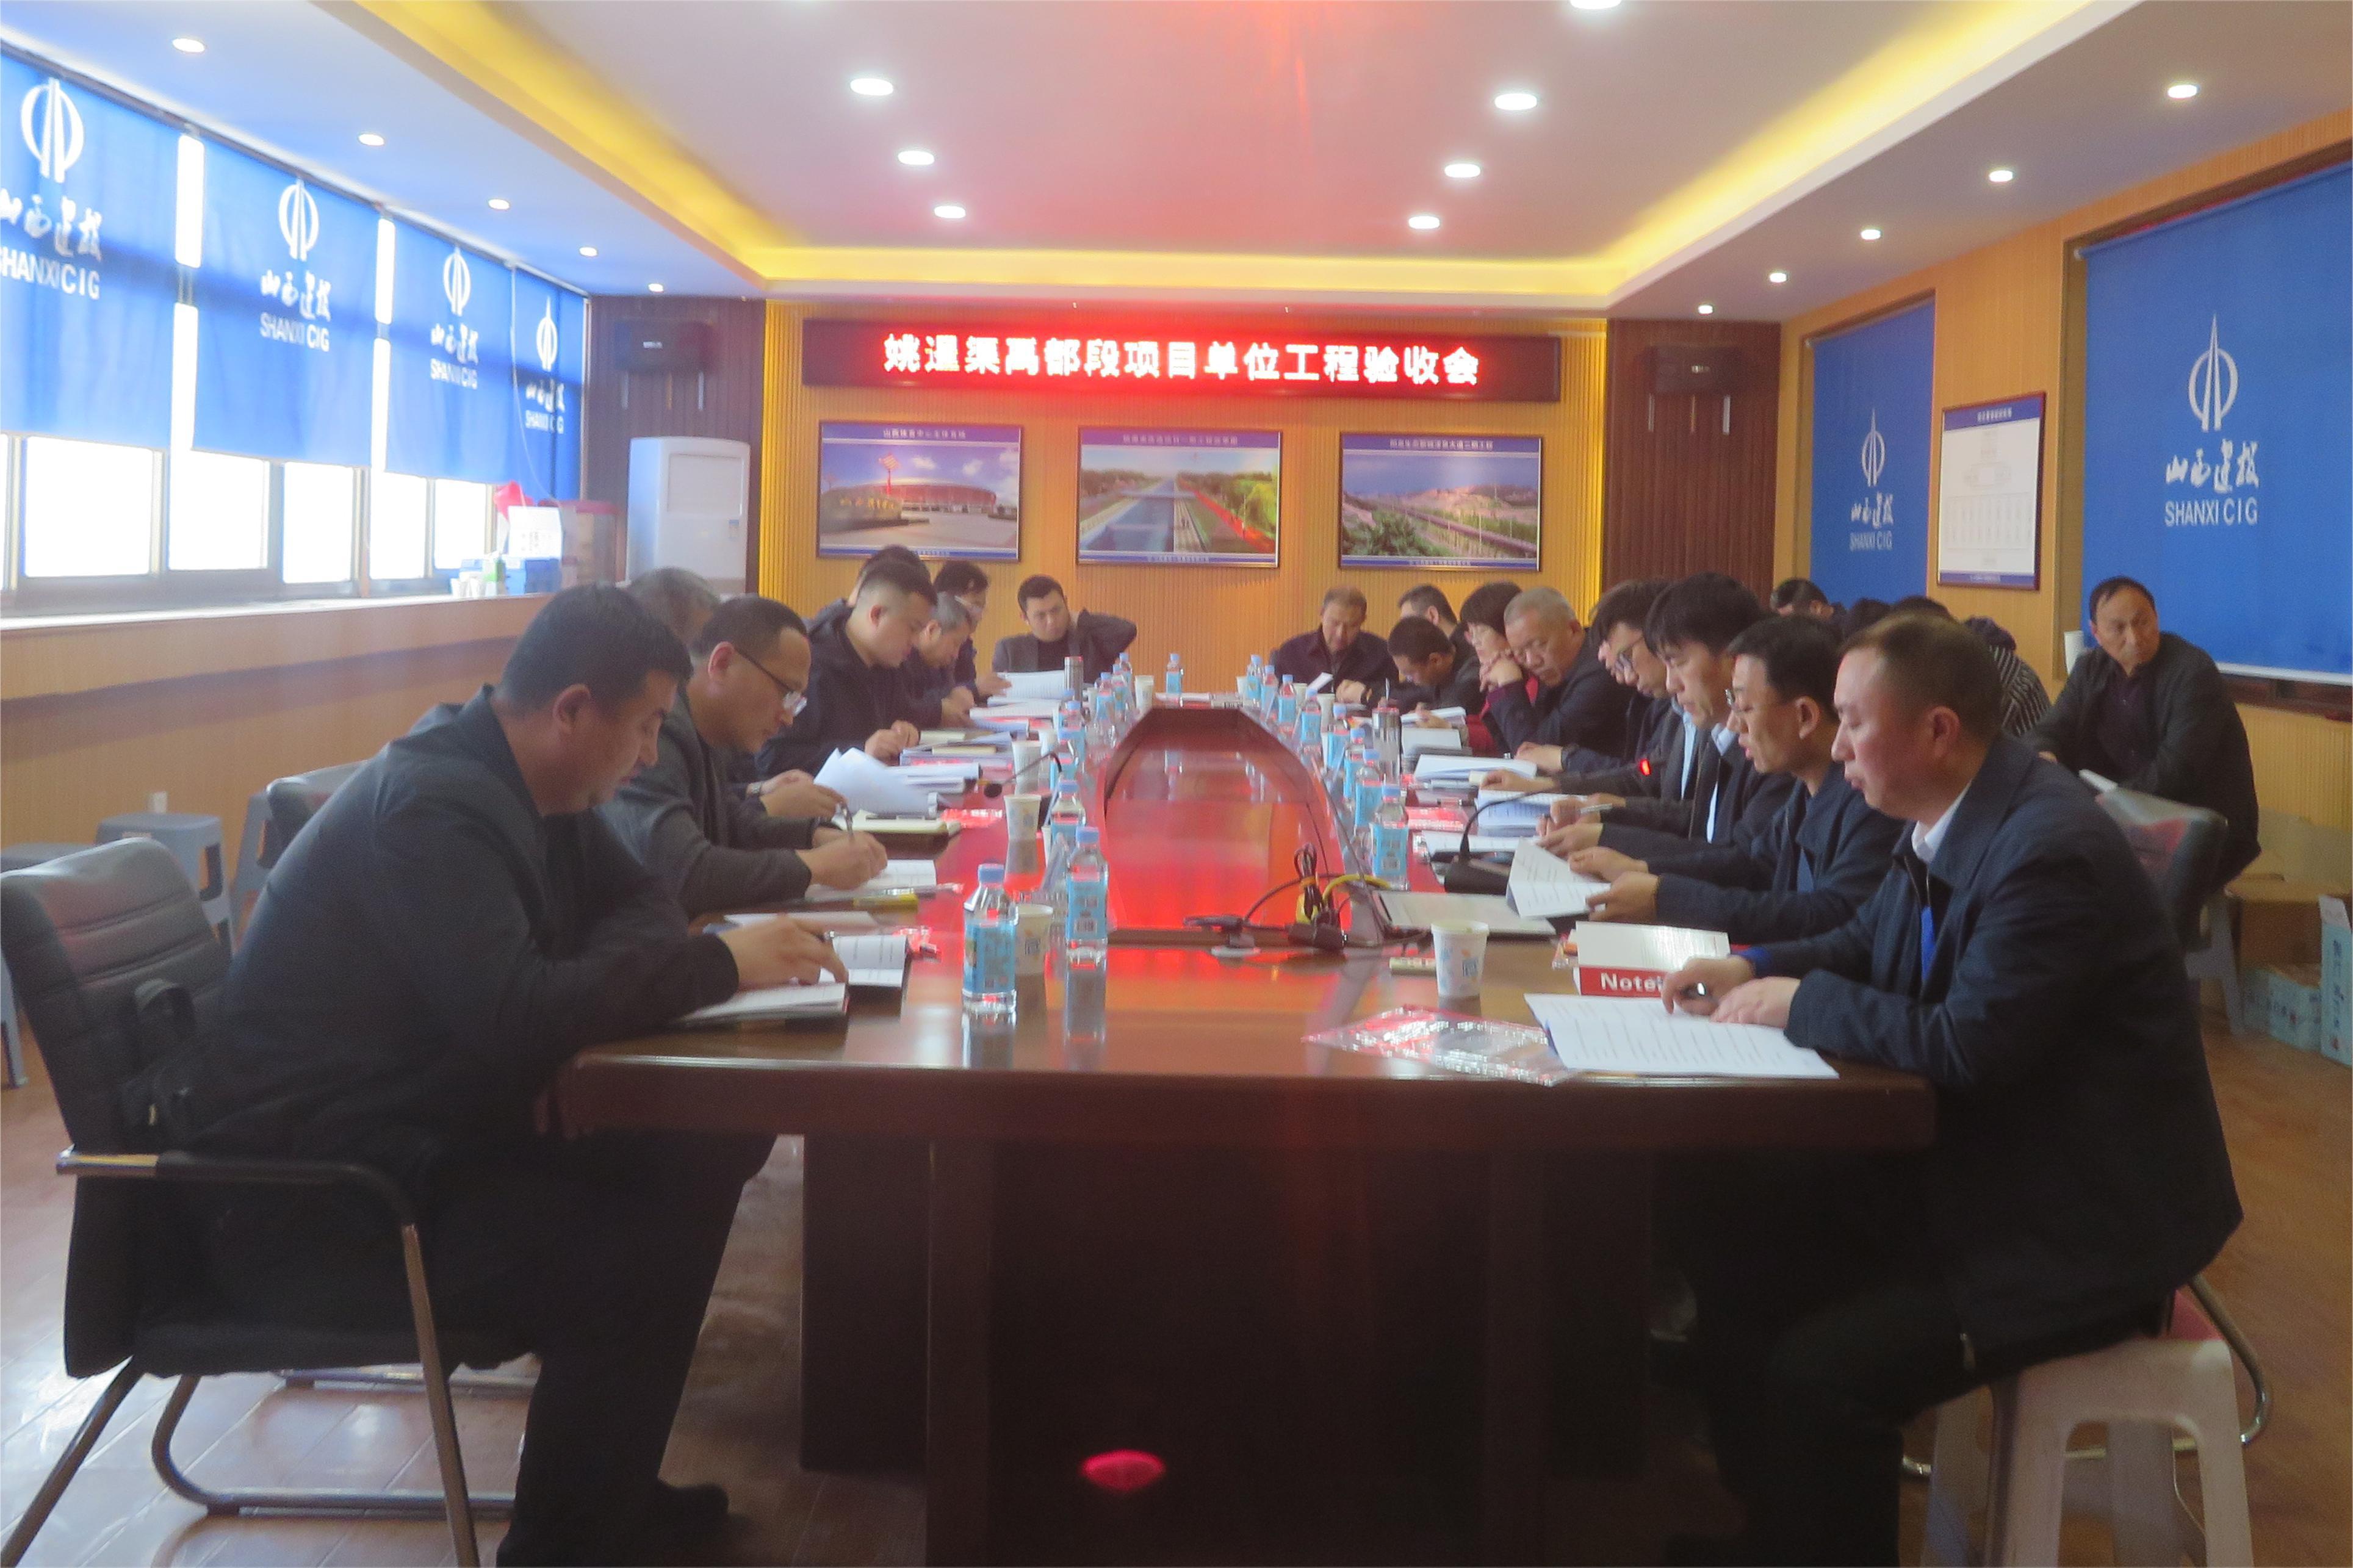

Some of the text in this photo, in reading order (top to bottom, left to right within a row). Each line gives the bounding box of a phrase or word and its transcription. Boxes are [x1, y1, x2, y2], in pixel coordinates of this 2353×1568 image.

[0, 246, 100, 300] HANXI CIG
[306, 323, 330, 352] CIG
[2165, 496, 2258, 527] SHANXI CIG
